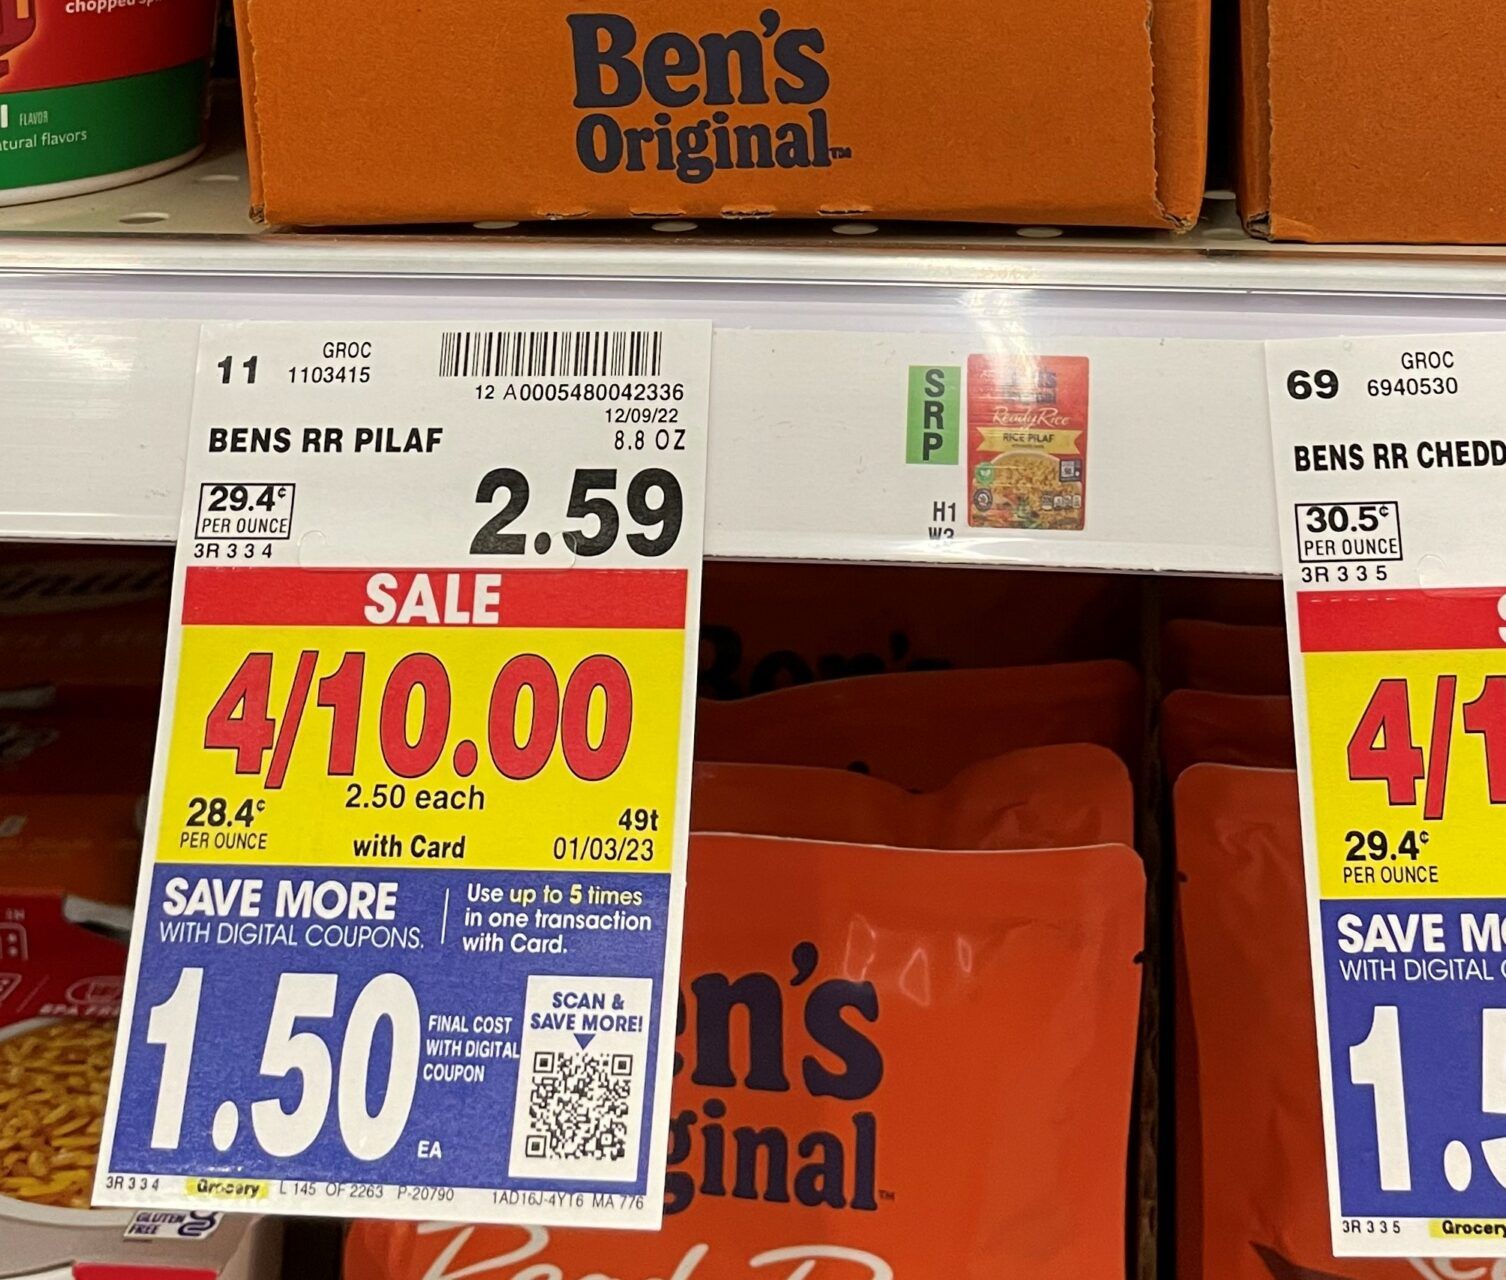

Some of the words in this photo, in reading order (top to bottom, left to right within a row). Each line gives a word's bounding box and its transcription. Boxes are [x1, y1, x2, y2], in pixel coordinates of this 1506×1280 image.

[566, 8, 830, 108] Ben's
[19, 111, 48, 126] FLAVOR
[42, 130, 87, 146] flavors
[575, 108, 832, 184] Original
[322, 341, 372, 359] GROC
[217, 355, 259, 384] 11
[1401, 352, 1455, 370] GROC
[288, 365, 371, 384] 1103415
[1286, 369, 1339, 400] 69
[475, 384, 495, 400] 12
[1367, 377, 1459, 396] 6940530
[605, 407, 679, 424] 12/09/22
[993, 406, 1036, 431] Ready
[208, 427, 291, 453] BENS
[301, 427, 343, 453] RR
[354, 427, 444, 454] PILAF
[614, 429, 645, 450] 8.8
[655, 429, 686, 450] OZ
[1003, 433, 1025, 442] RICE
[1027, 434, 1055, 443] PILAF
[1294, 443, 1365, 472] BENS
[1373, 442, 1409, 470] RR
[469, 467, 684, 557] 2.59
[933, 501, 956, 522] H1
[202, 517, 231, 533] PER
[236, 517, 287, 534] OUNCE
[1304, 539, 1336, 556] PER
[1341, 538, 1398, 555] OUNCE
[364, 573, 501, 624] SALE
[204, 650, 633, 790] 4/10.00
[345, 785, 405, 809] 2.50
[415, 785, 485, 810] each
[618, 809, 659, 832] 49t
[180, 833, 210, 848] PER
[215, 833, 268, 850] OUNCE
[353, 835, 402, 859] with
[410, 835, 465, 859] Card
[553, 837, 654, 861] 01/03/23
[1343, 866, 1375, 884] PER
[1381, 865, 1439, 883] OUNCE
[162, 877, 264, 918] SAVE
[275, 881, 399, 920] MORE
[467, 883, 503, 903] Use
[508, 888, 536, 909] up
[542, 887, 564, 905] to
[570, 886, 583, 904] 5
[588, 887, 643, 906] times
[464, 908, 482, 926] in
[488, 912, 529, 929] one
[534, 910, 652, 931] transaction
[159, 921, 210, 943] WITH
[217, 923, 298, 947] DIGITAL
[305, 925, 424, 950] COUPONS.
[462, 933, 504, 952] with
[510, 933, 568, 954] Card.
[1337, 913, 1446, 953] SAVE
[1339, 959, 1396, 981] WITH
[1404, 958, 1494, 981] DIGITAL
[552, 992, 606, 1010] SCAN
[612, 994, 625, 1010] &
[428, 1015, 468, 1033] FINAL
[473, 1016, 513, 1034] COST
[530, 1013, 577, 1030] SAVE
[582, 1014, 643, 1033] MORE!
[426, 1040, 462, 1057] WITH
[465, 1040, 520, 1059] DIGITAL
[146, 967, 421, 1161] 1.50
[423, 1063, 485, 1082] COUPON
[417, 1141, 442, 1159] EA
[293, 1182, 317, 1196] 145
[350, 1183, 384, 1199] 2263
[591, 1195, 614, 1209] MA
[620, 1195, 644, 1210] 776
[136, 1212, 186, 1224] GLUTEN
[128, 1224, 160, 1235] FREE
